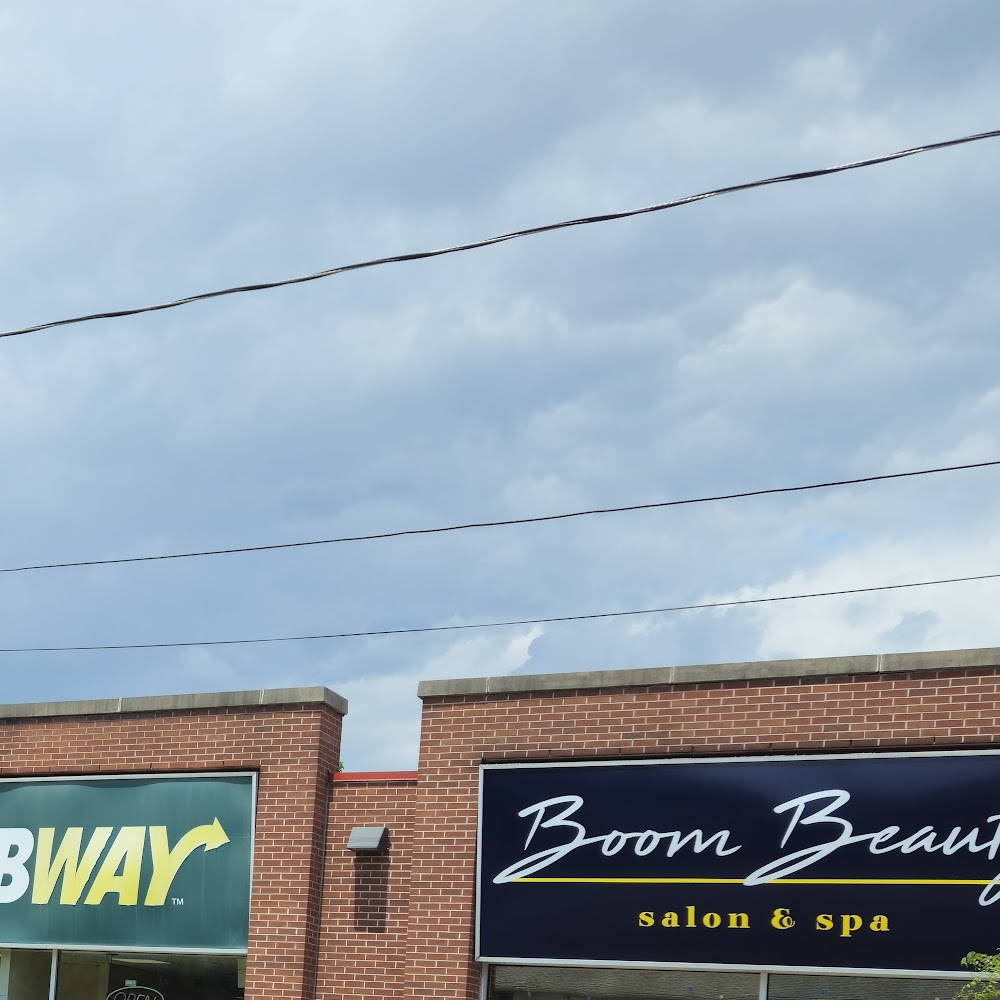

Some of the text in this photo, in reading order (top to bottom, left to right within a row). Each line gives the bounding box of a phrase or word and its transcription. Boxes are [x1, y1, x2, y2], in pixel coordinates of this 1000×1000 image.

[493, 789, 1000, 906] Boom Beaut
[638, 906, 890, 938] salon & spa
